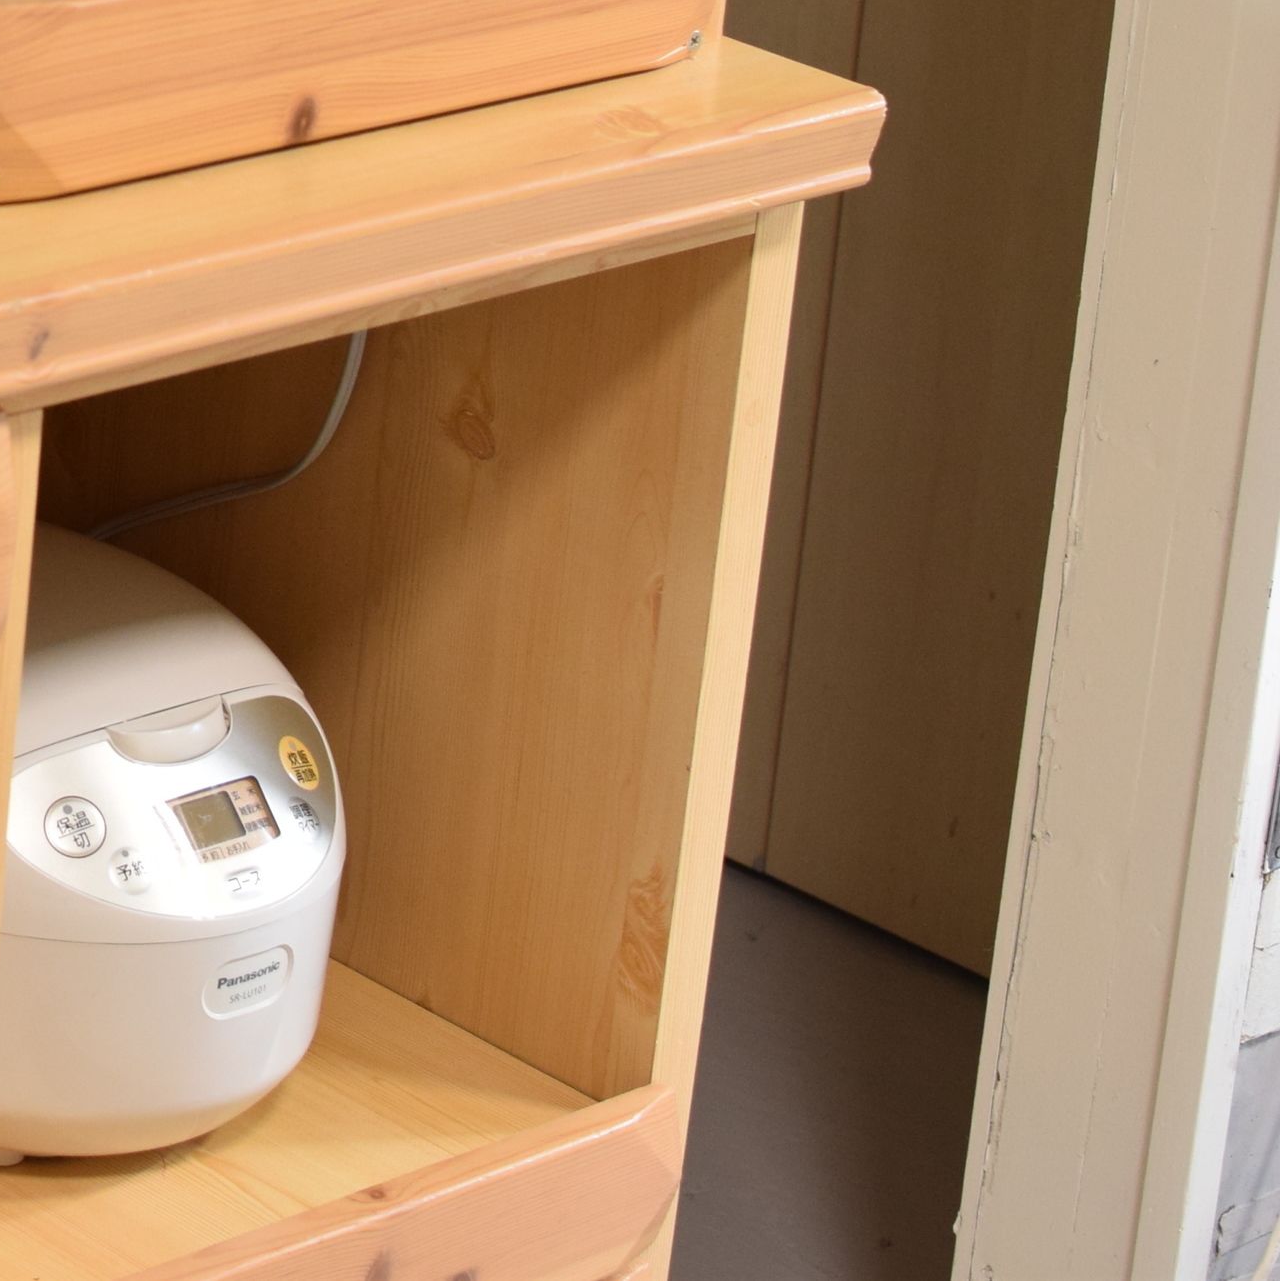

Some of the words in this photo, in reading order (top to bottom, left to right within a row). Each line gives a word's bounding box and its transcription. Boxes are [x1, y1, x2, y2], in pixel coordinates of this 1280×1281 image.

[56, 809, 92, 835] 保温
[73, 831, 91, 850] 切
[216, 959, 281, 990] Panasonic
